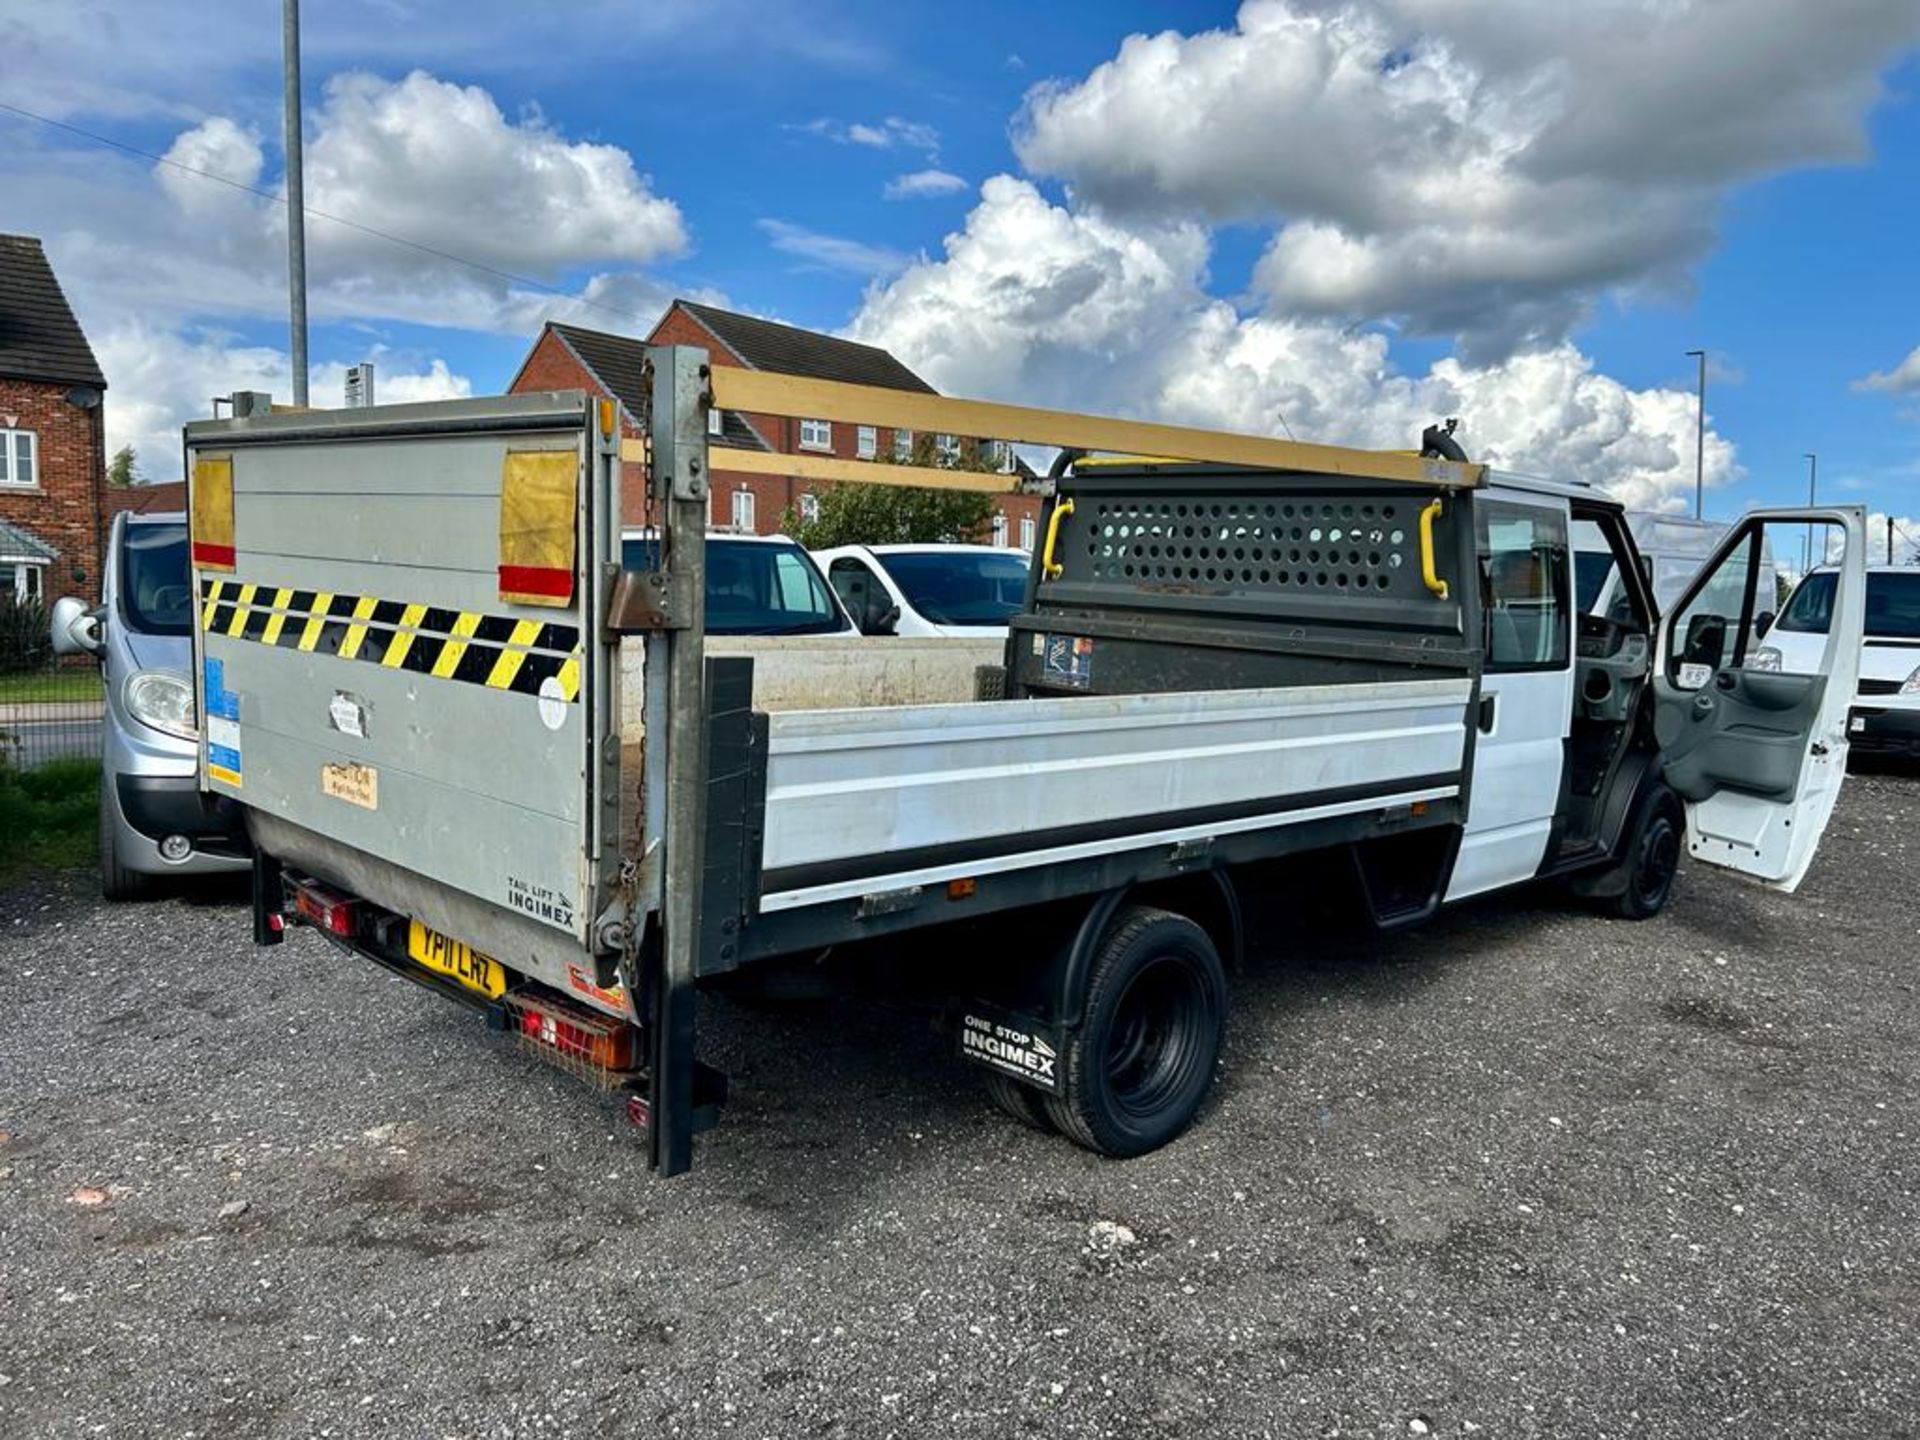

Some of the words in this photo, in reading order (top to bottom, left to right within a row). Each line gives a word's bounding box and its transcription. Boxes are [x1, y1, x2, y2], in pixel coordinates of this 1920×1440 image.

[508, 889, 573, 928] INGIMEX
[532, 886, 553, 901] LIFT
[964, 1015, 992, 1033] ONE
[996, 1025, 1030, 1045] STOP
[963, 1029, 1055, 1078] INGIMEX
